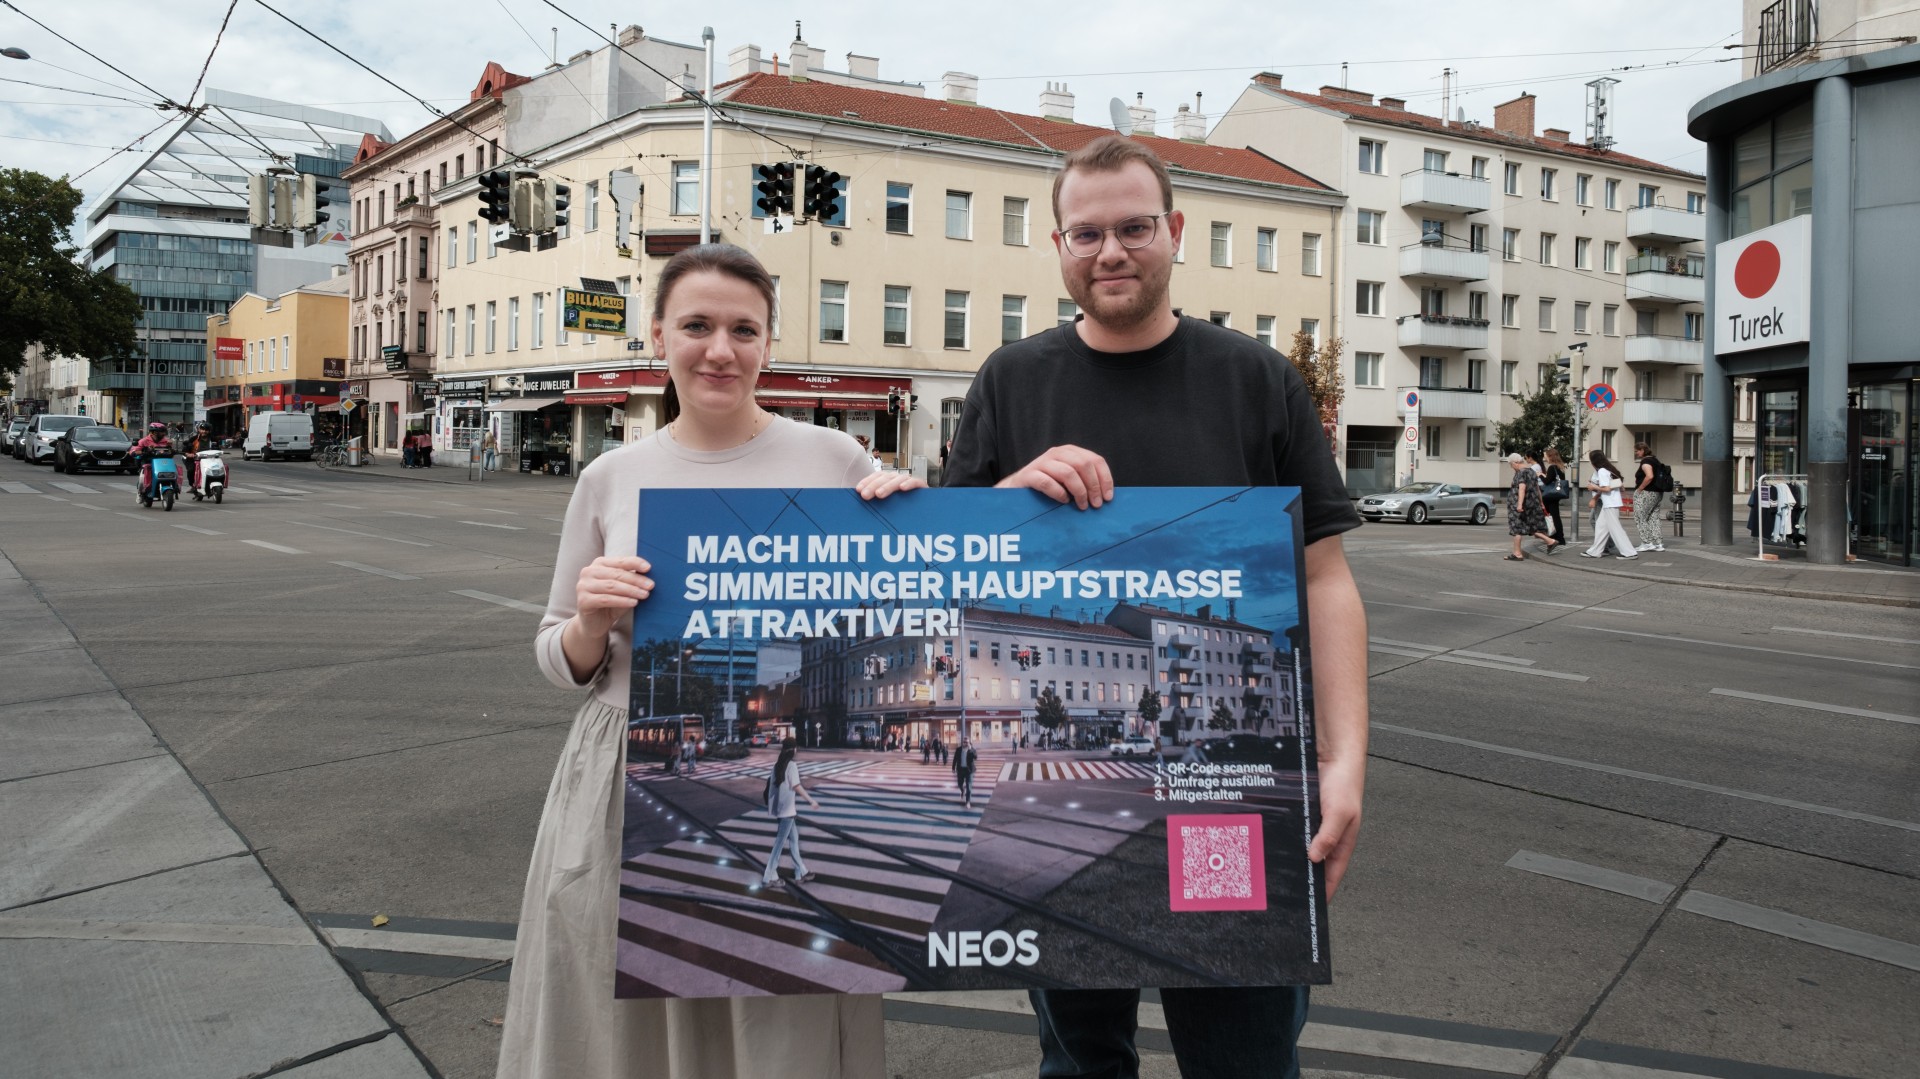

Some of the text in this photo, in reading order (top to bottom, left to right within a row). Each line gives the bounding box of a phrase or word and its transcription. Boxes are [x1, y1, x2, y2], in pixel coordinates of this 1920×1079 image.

[566, 291, 623, 308] BILLA PLUS
[569, 312, 575, 320] P
[1728, 306, 1784, 342] Turek
[602, 372, 616, 380] ANKER
[805, 376, 832, 384] ANKER
[523, 380, 570, 392] AUGE JUWELIER
[1408, 430, 1415, 438] 30
[686, 533, 1021, 564] MACH MIT UNS DIE
[683, 569, 1243, 601] SIMMERINGER HAUPTSTRASSE
[683, 607, 959, 639] ATTRAKTIVER!
[1155, 762, 1273, 775] 1. QR-Code scannen
[1154, 775, 1275, 790] 2. Umfrage ausfüllen
[1154, 789, 1243, 803] 3. Mitgestalten
[928, 929, 1040, 968] NEOS
